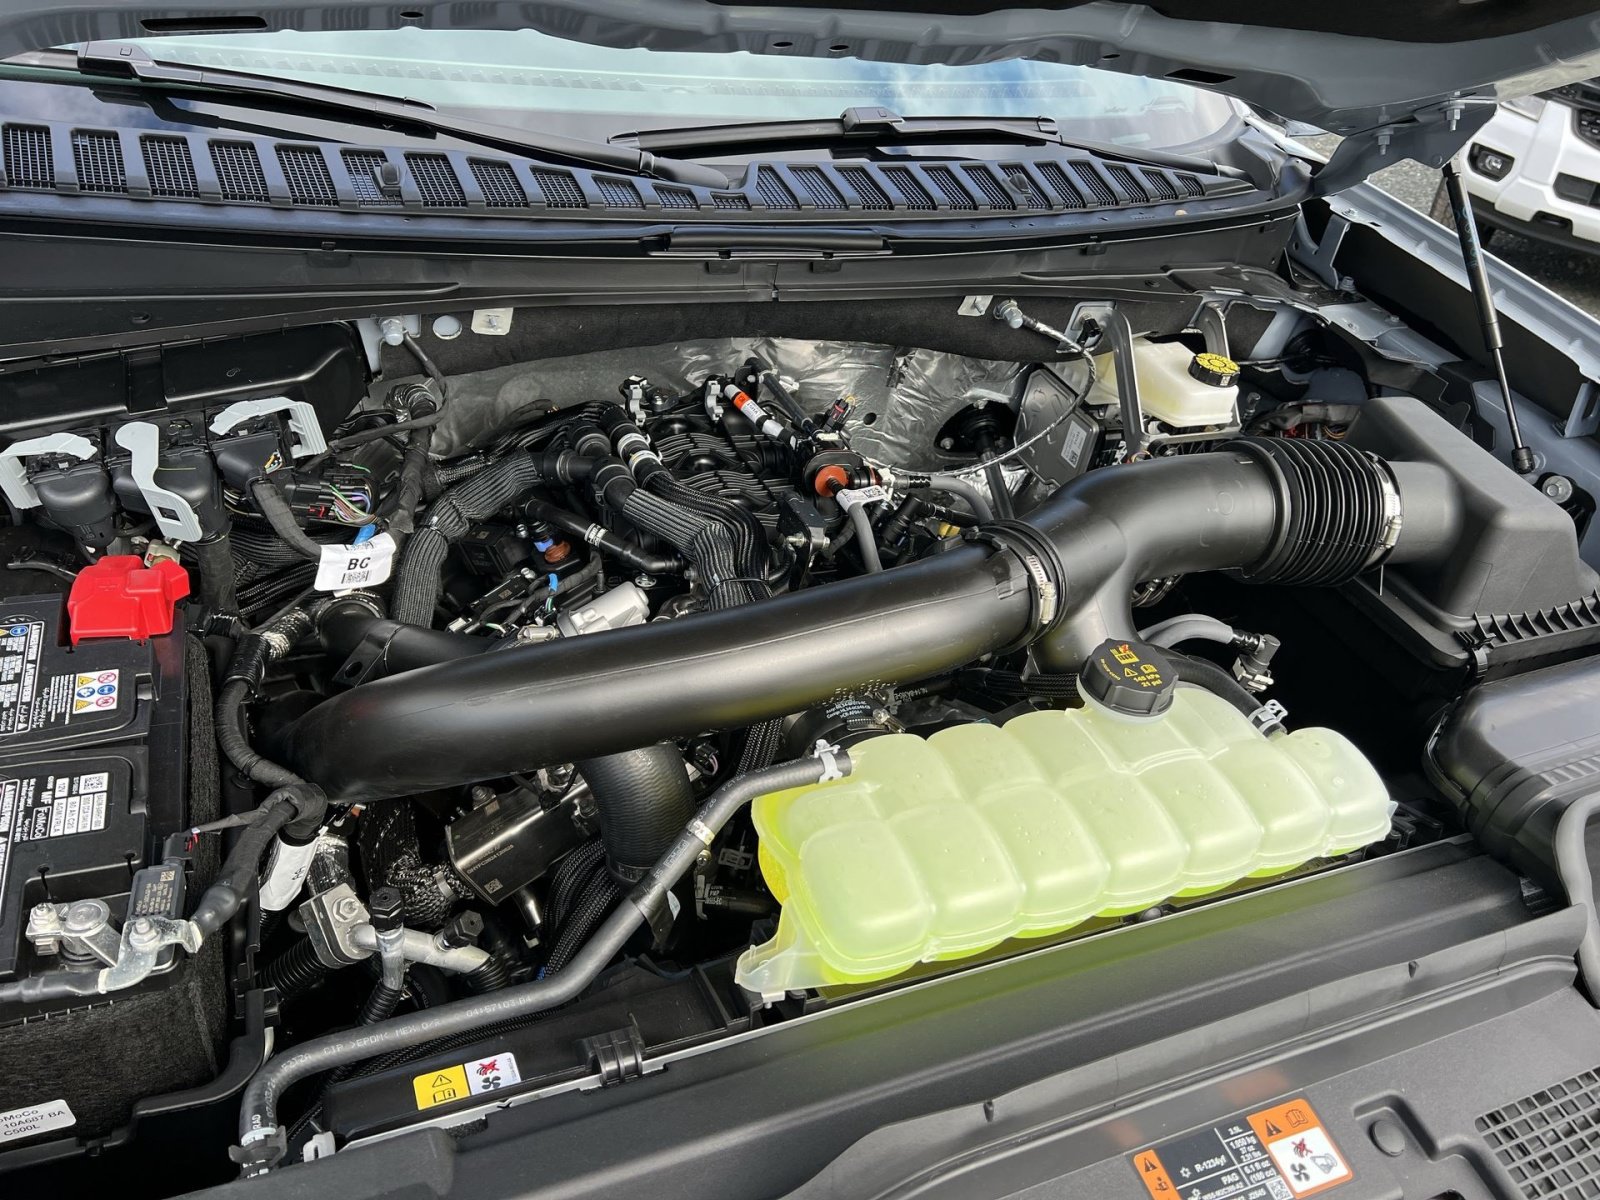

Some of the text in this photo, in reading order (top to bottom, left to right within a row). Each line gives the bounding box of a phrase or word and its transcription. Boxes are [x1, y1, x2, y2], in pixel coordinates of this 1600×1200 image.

[34, 807, 48, 838] FoMoCo
[1245, 1136, 1257, 1145] kg
[1194, 1154, 1227, 1173] R-1234yf
[1221, 1172, 1239, 1185] PAG
